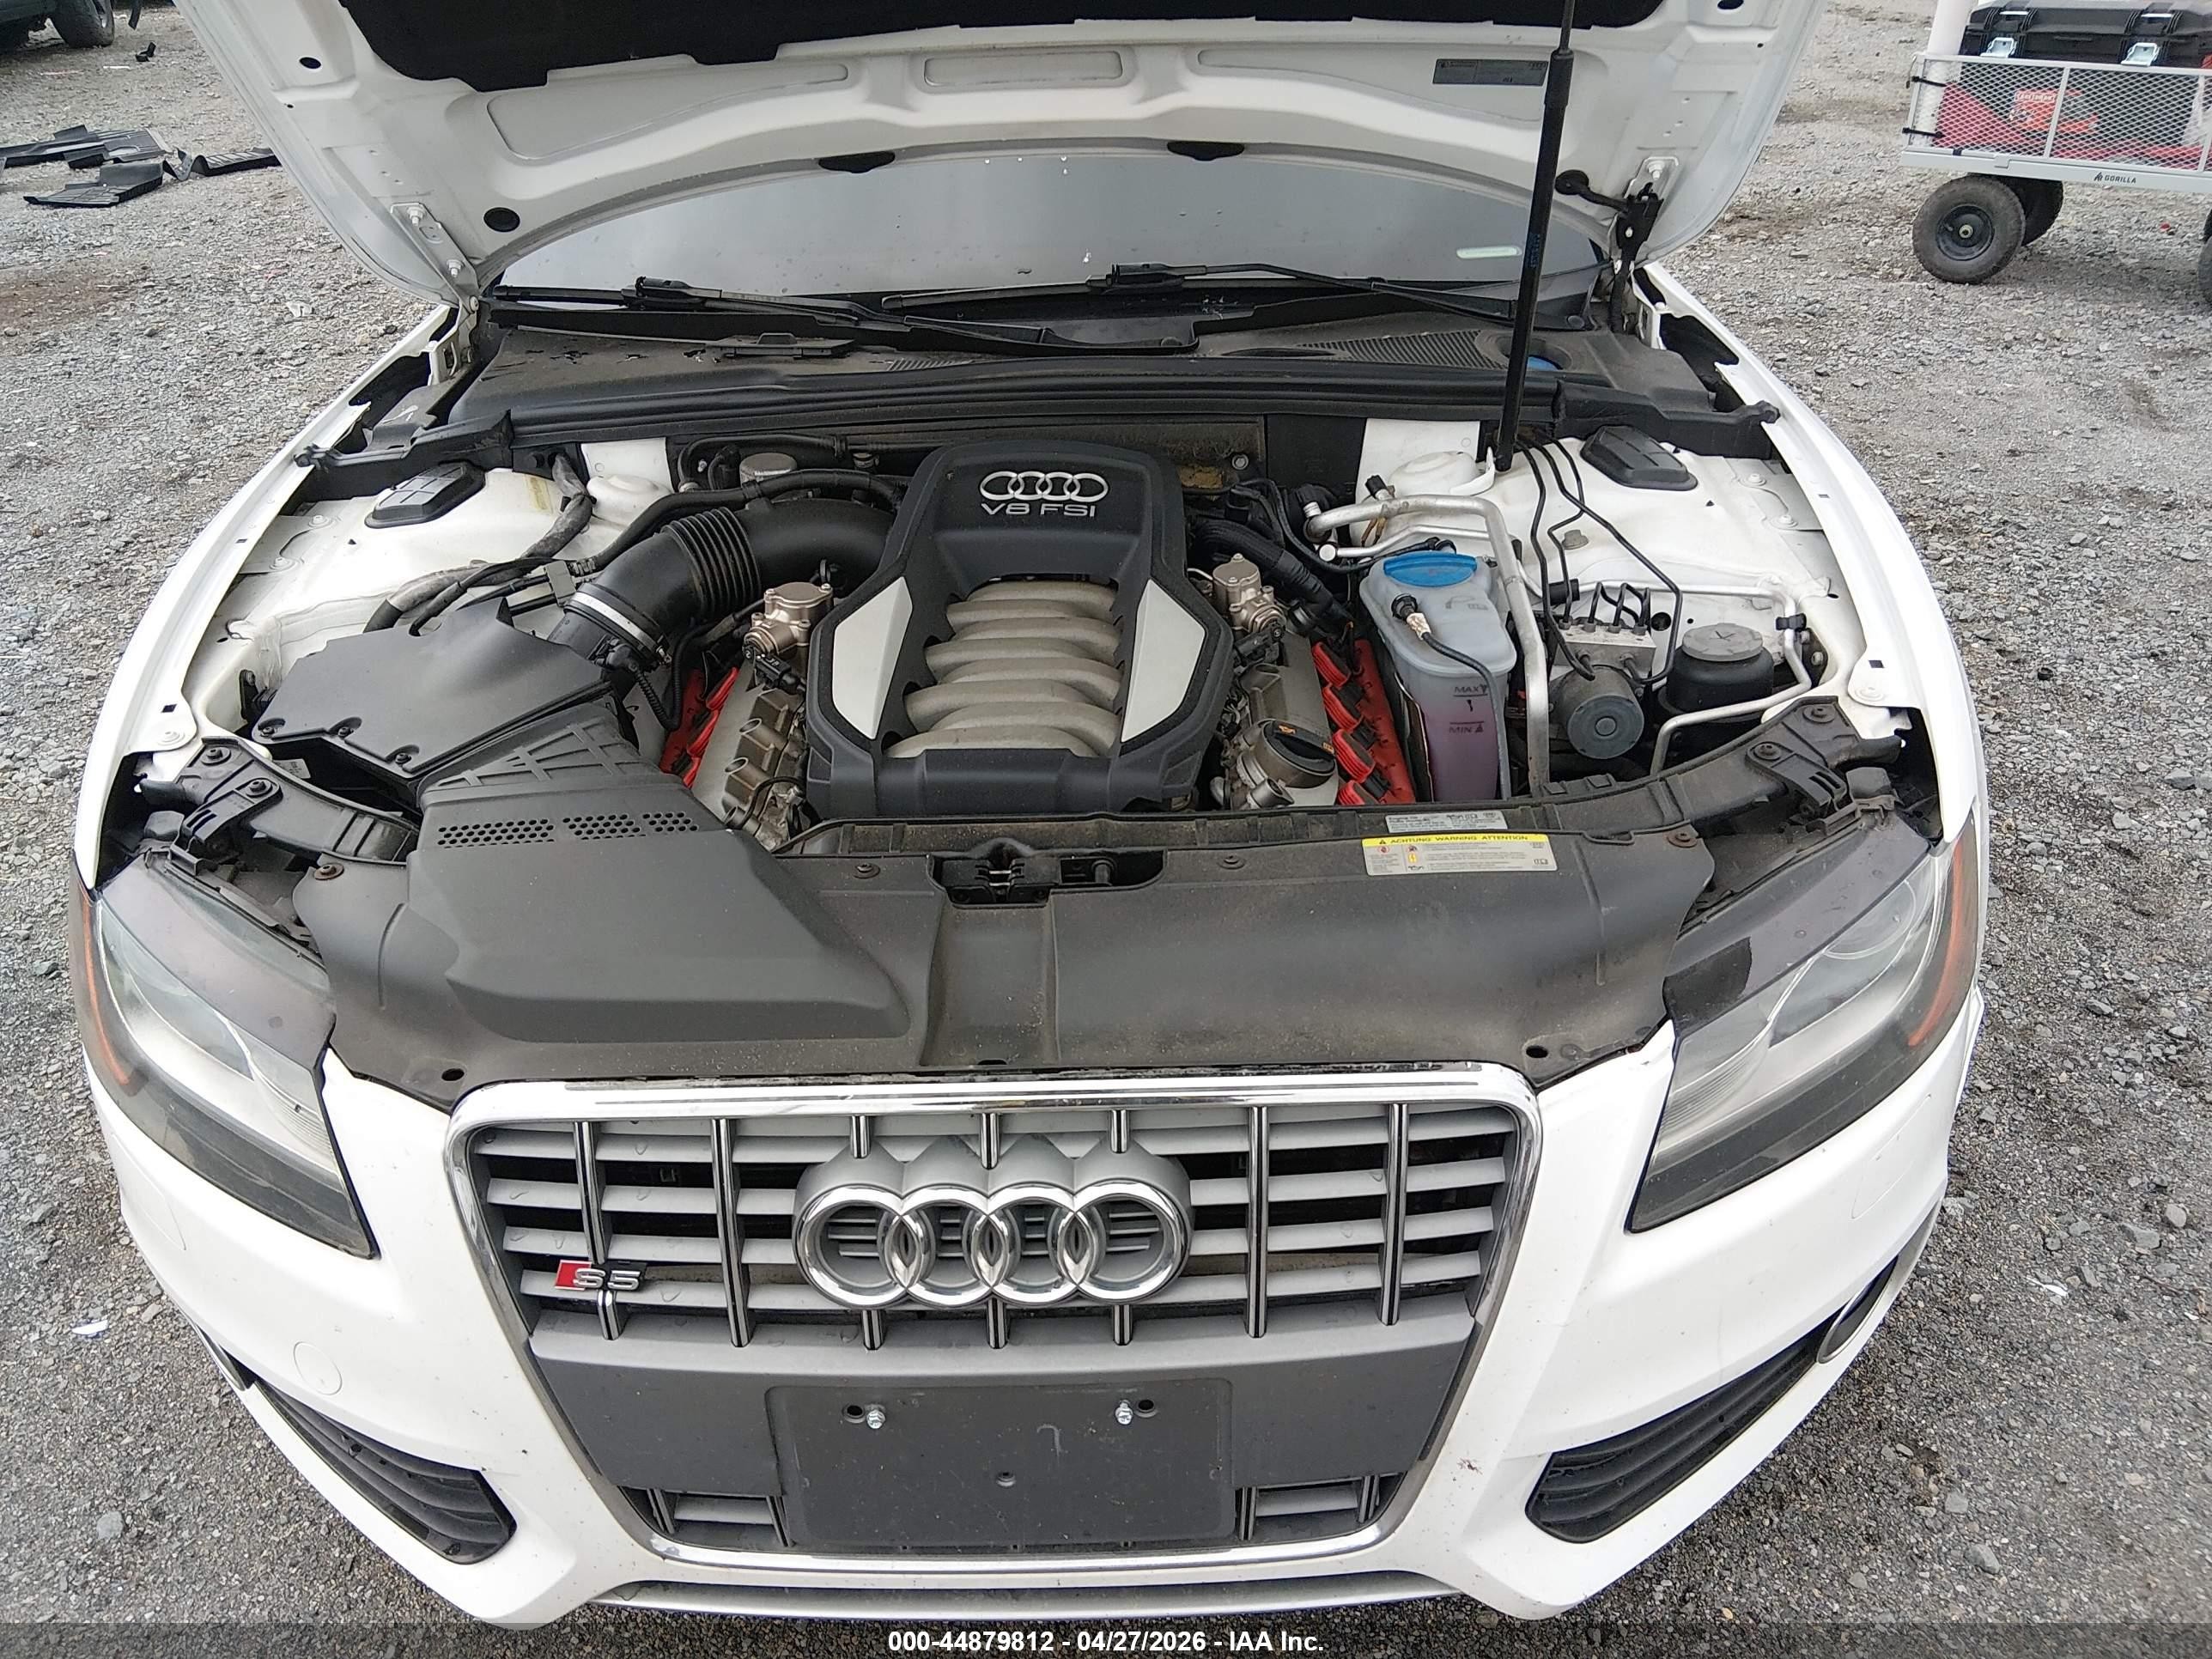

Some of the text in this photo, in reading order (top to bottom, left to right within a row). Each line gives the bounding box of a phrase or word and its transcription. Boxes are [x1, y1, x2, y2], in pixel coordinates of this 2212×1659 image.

[2104, 174, 2136, 183] GORILLA
[981, 502, 1097, 517] V8 FSI
[573, 1267, 640, 1291] S5
